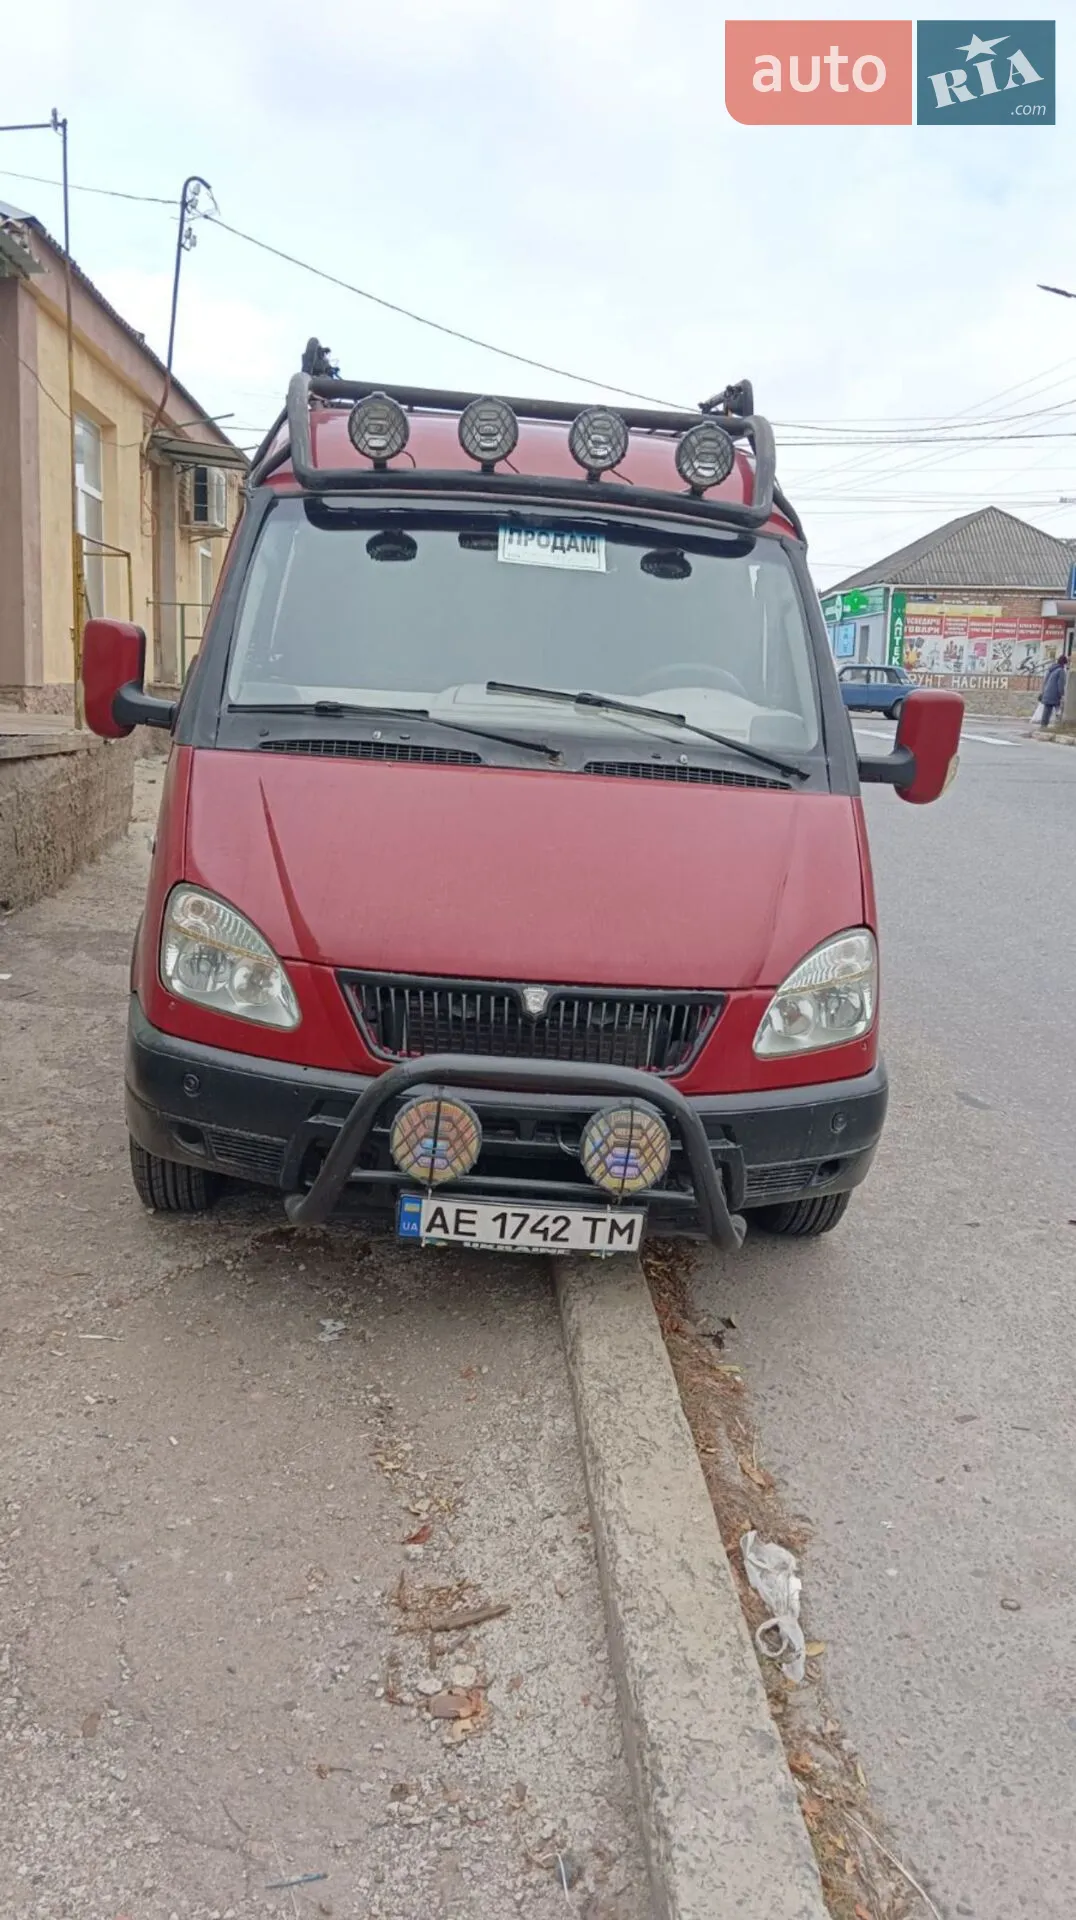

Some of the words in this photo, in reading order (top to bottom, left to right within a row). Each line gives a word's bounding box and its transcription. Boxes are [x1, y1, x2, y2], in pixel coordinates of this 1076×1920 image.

[507, 527, 597, 554] ПРОДАМ
[891, 617, 903, 666] АПТЕК
[908, 673, 945, 688] РУНТ
[951, 675, 1009, 690] НАСІННЯ
[402, 1221, 419, 1232] UA
[425, 1206, 478, 1237] AE
[491, 1211, 572, 1243] 1742
[582, 1216, 636, 1245] TM
